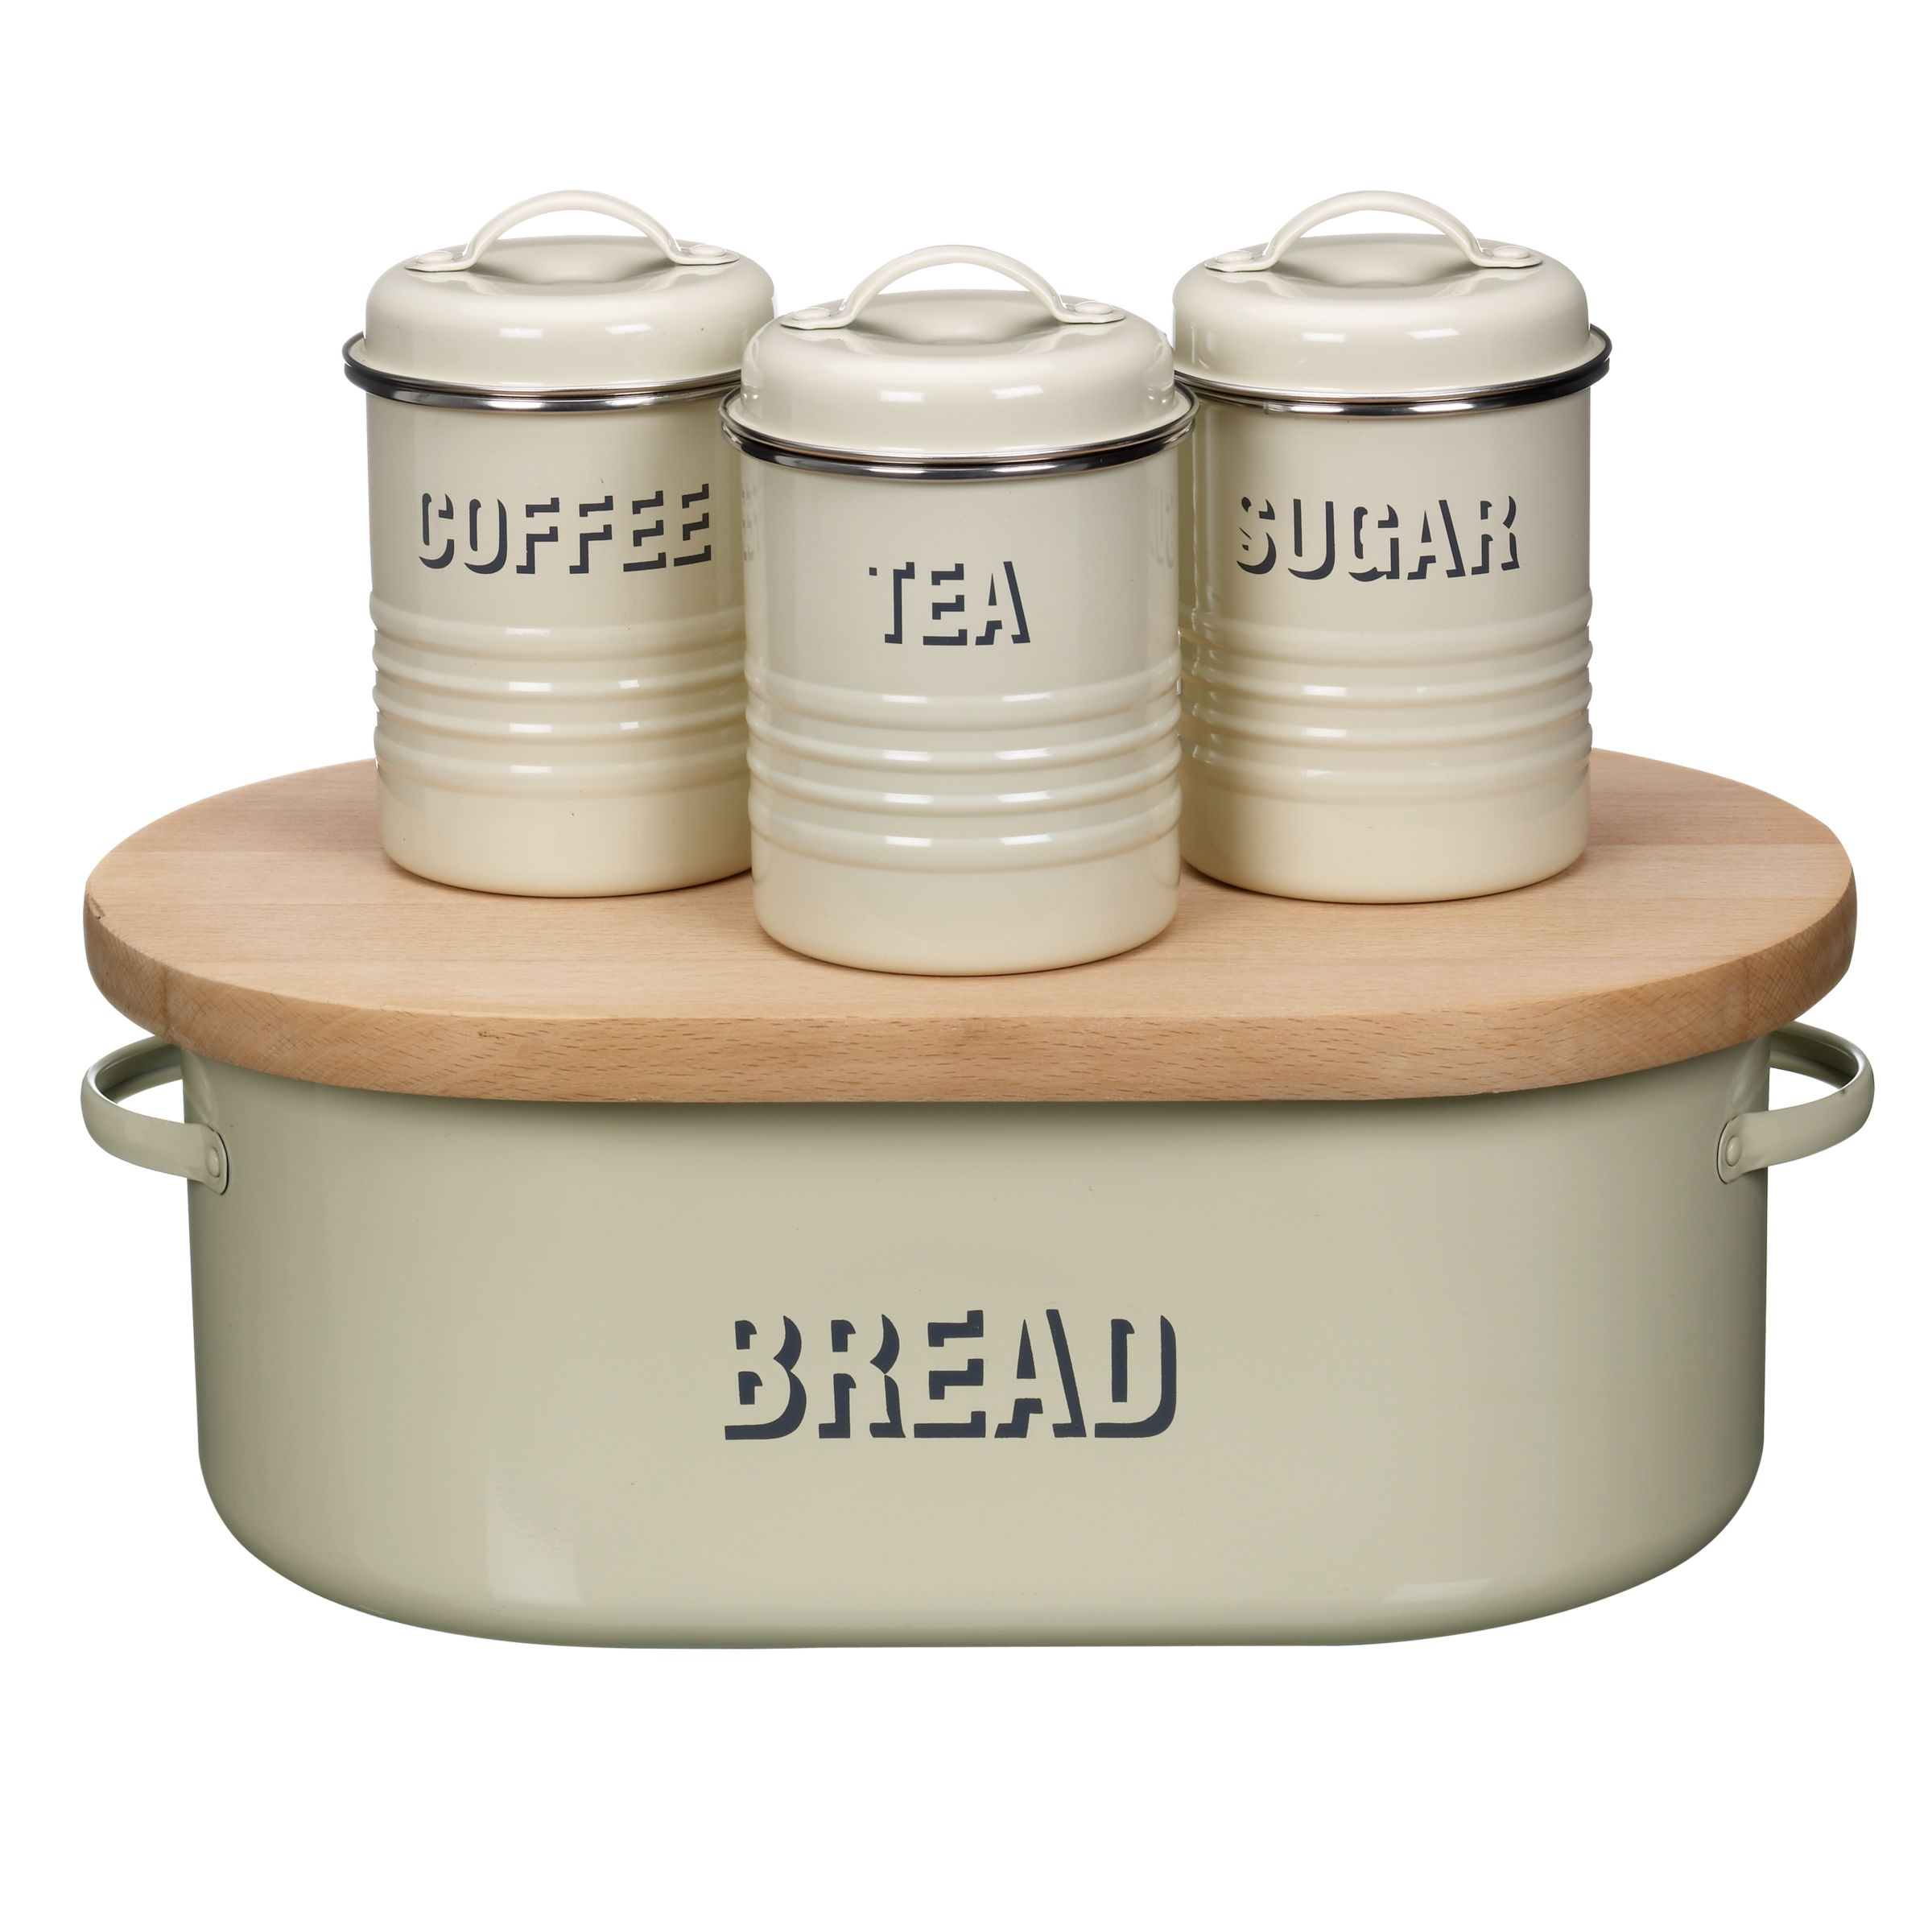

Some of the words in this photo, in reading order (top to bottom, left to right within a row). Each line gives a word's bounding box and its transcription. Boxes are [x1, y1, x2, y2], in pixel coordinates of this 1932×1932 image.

[418, 482, 712, 576] COFFEE
[1236, 495, 1521, 583] SUGAR
[868, 560, 1031, 646] TEA
[724, 1308, 1178, 1441] BREAD
